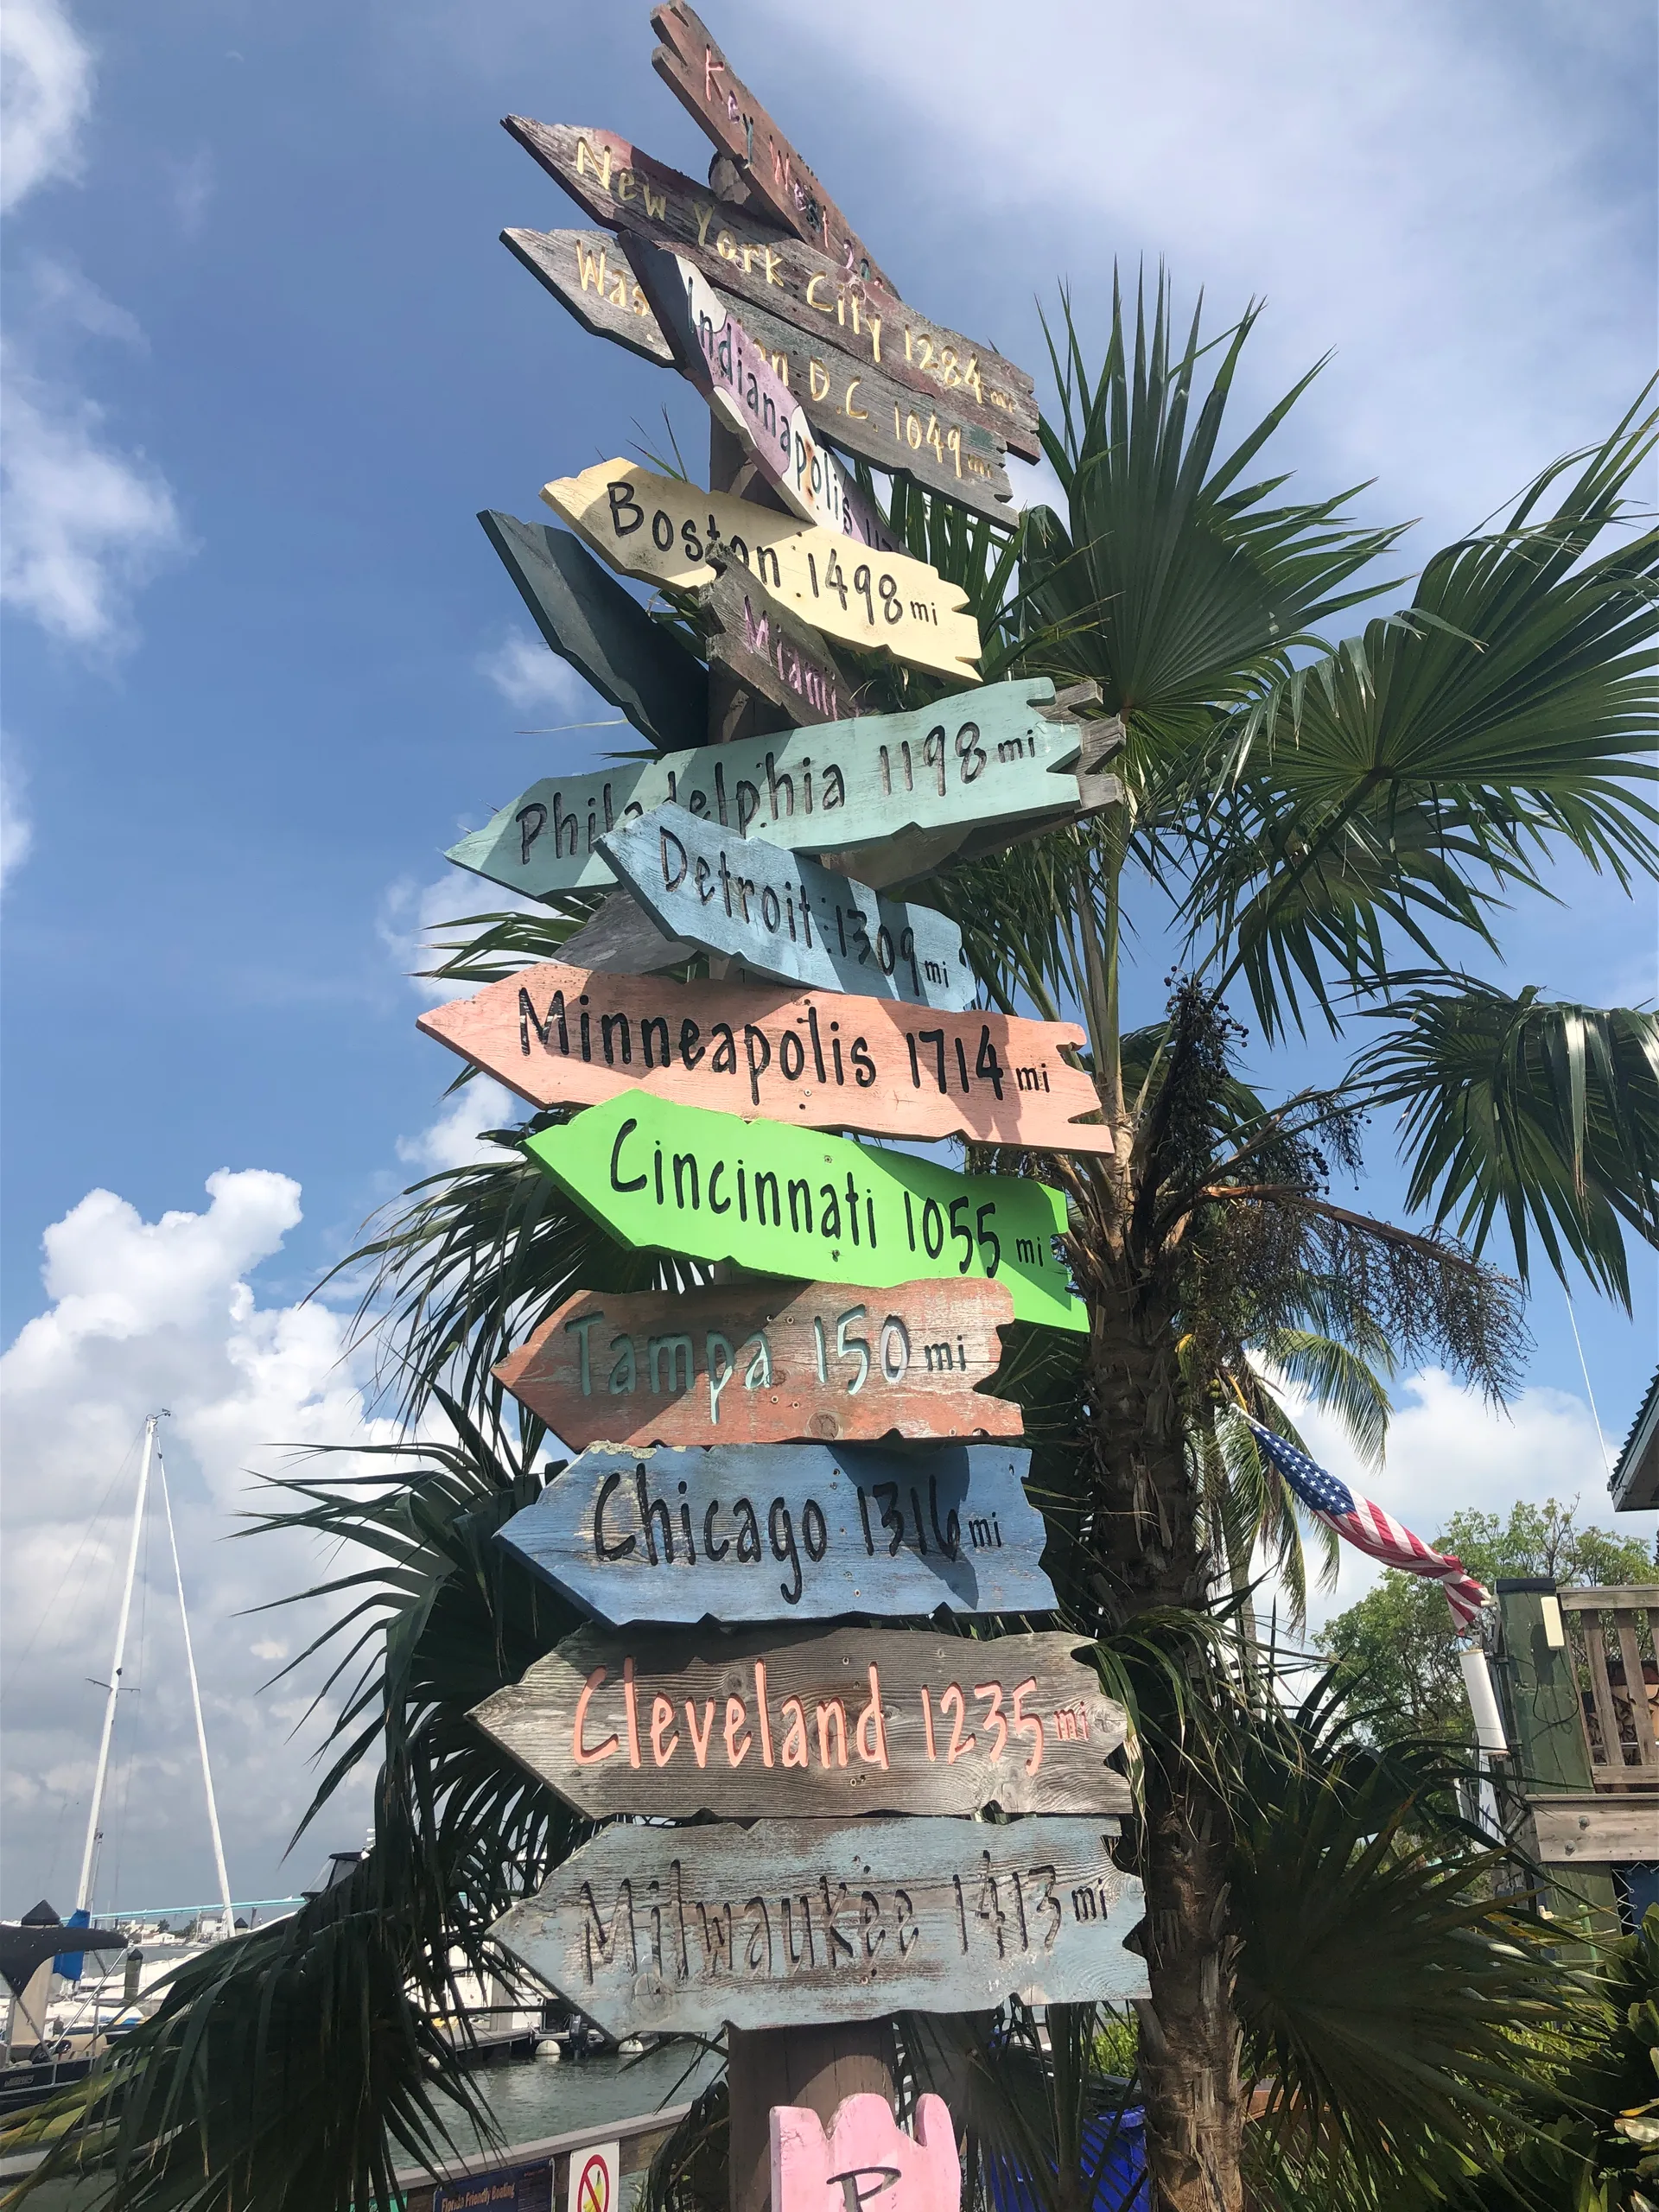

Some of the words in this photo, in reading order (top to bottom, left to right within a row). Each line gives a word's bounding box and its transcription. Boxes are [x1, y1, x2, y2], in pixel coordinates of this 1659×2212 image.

[576, 137, 667, 221] New
[693, 200, 785, 287] York
[807, 271, 881, 362] City
[905, 324, 984, 404] 1284
[688, 276, 853, 536] Indianapolis
[894, 400, 963, 479] 1049
[607, 481, 781, 588] Boston
[808, 548, 904, 626] 1498
[910, 600, 938, 626] mi
[744, 594, 838, 721] Miami
[880, 721, 987, 797] 1198
[998, 729, 1035, 764] mi
[659, 826, 812, 949] Detroit
[836, 904, 920, 997] 1309
[925, 959, 949, 989] mi
[518, 987, 876, 1105] Minneapolis
[906, 1024, 1004, 1101] 1714
[1015, 1062, 1050, 1094] mi
[611, 1118, 876, 1249] Cincinnati
[904, 1190, 1001, 1278] 1055
[1015, 1235, 1044, 1267] mi
[564, 1310, 772, 1426] Tampa
[814, 1304, 910, 1395] 150
[925, 1334, 966, 1372] mi
[594, 1463, 827, 1605] Chicago
[857, 1474, 960, 1562] 1316
[969, 1512, 1002, 1548] mi
[572, 1656, 889, 1770] Cleveland
[921, 1675, 1046, 1777] 1235
[1053, 1700, 1090, 1742] mi
[580, 1859, 919, 1985] Milwaukee
[952, 1849, 1063, 1959] 1413
[1071, 1878, 1107, 1923] mi
